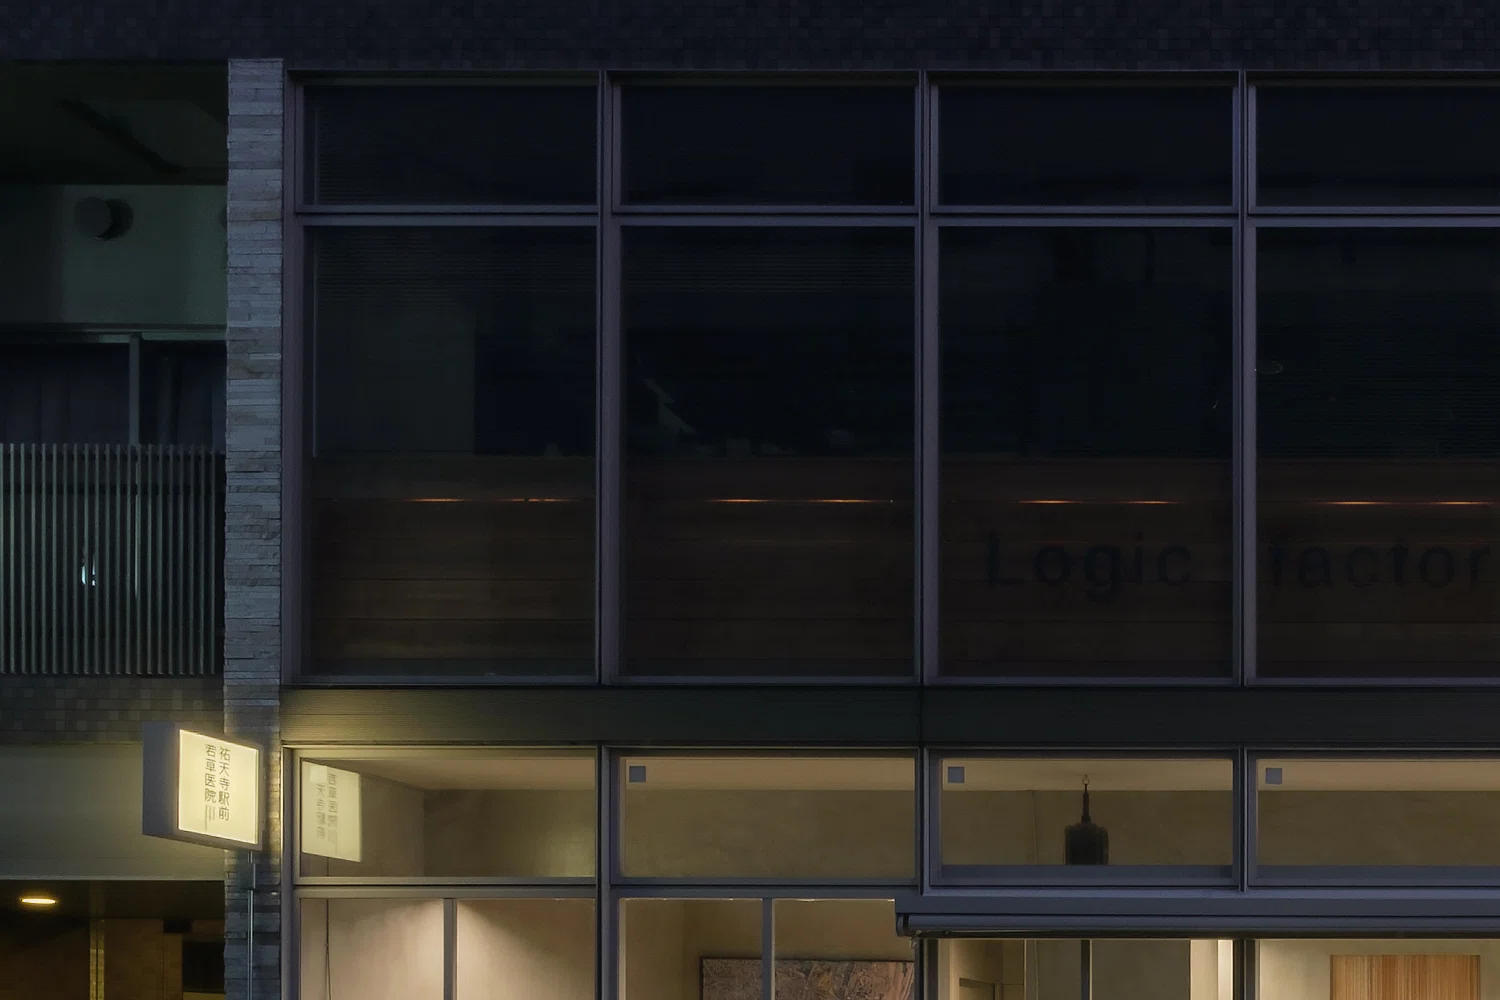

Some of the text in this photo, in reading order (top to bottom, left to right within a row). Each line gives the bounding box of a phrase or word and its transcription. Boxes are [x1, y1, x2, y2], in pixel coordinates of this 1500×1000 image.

[983, 530, 1193, 603] Logic
[205, 744, 216, 803] 若草医院
[219, 747, 231, 821] 祐天寺駅前
